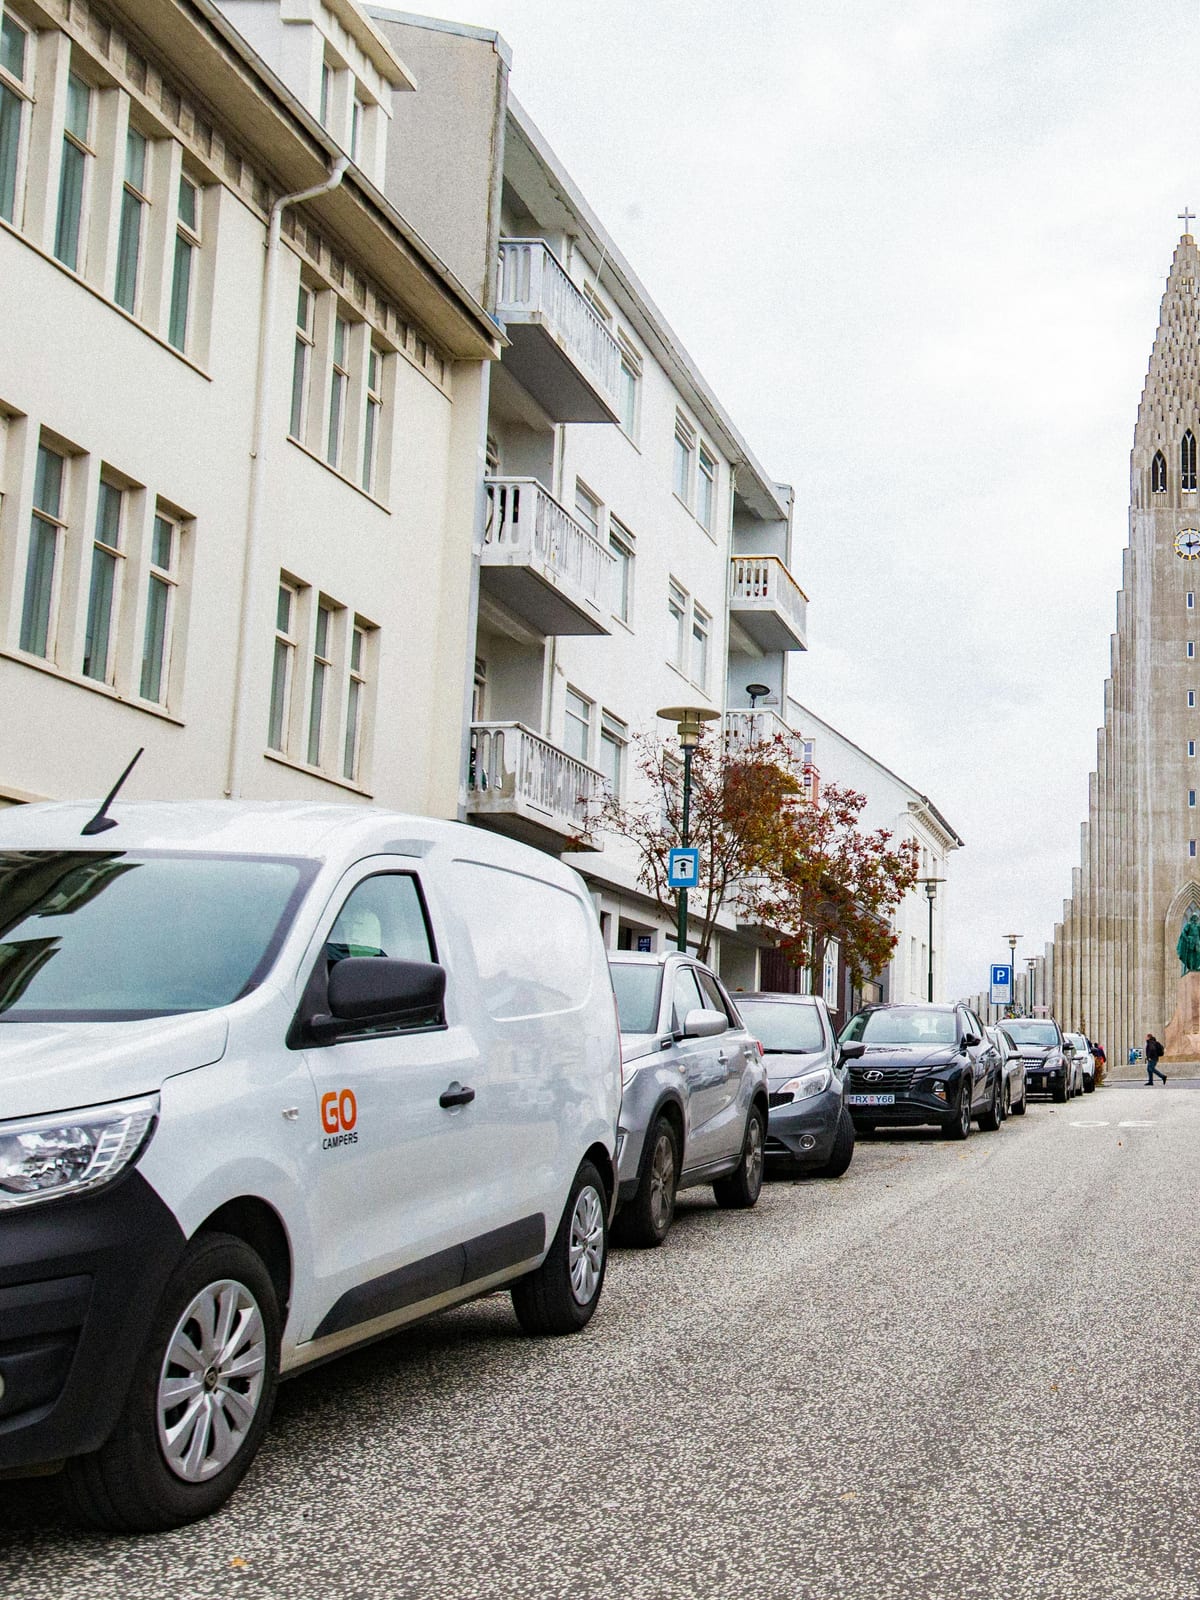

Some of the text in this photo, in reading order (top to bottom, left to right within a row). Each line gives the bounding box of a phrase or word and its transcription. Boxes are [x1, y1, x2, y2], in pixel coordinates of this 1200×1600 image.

[996, 970, 1006, 982] P
[321, 1088, 358, 1134] GO
[322, 1132, 358, 1150] CAMPERS
